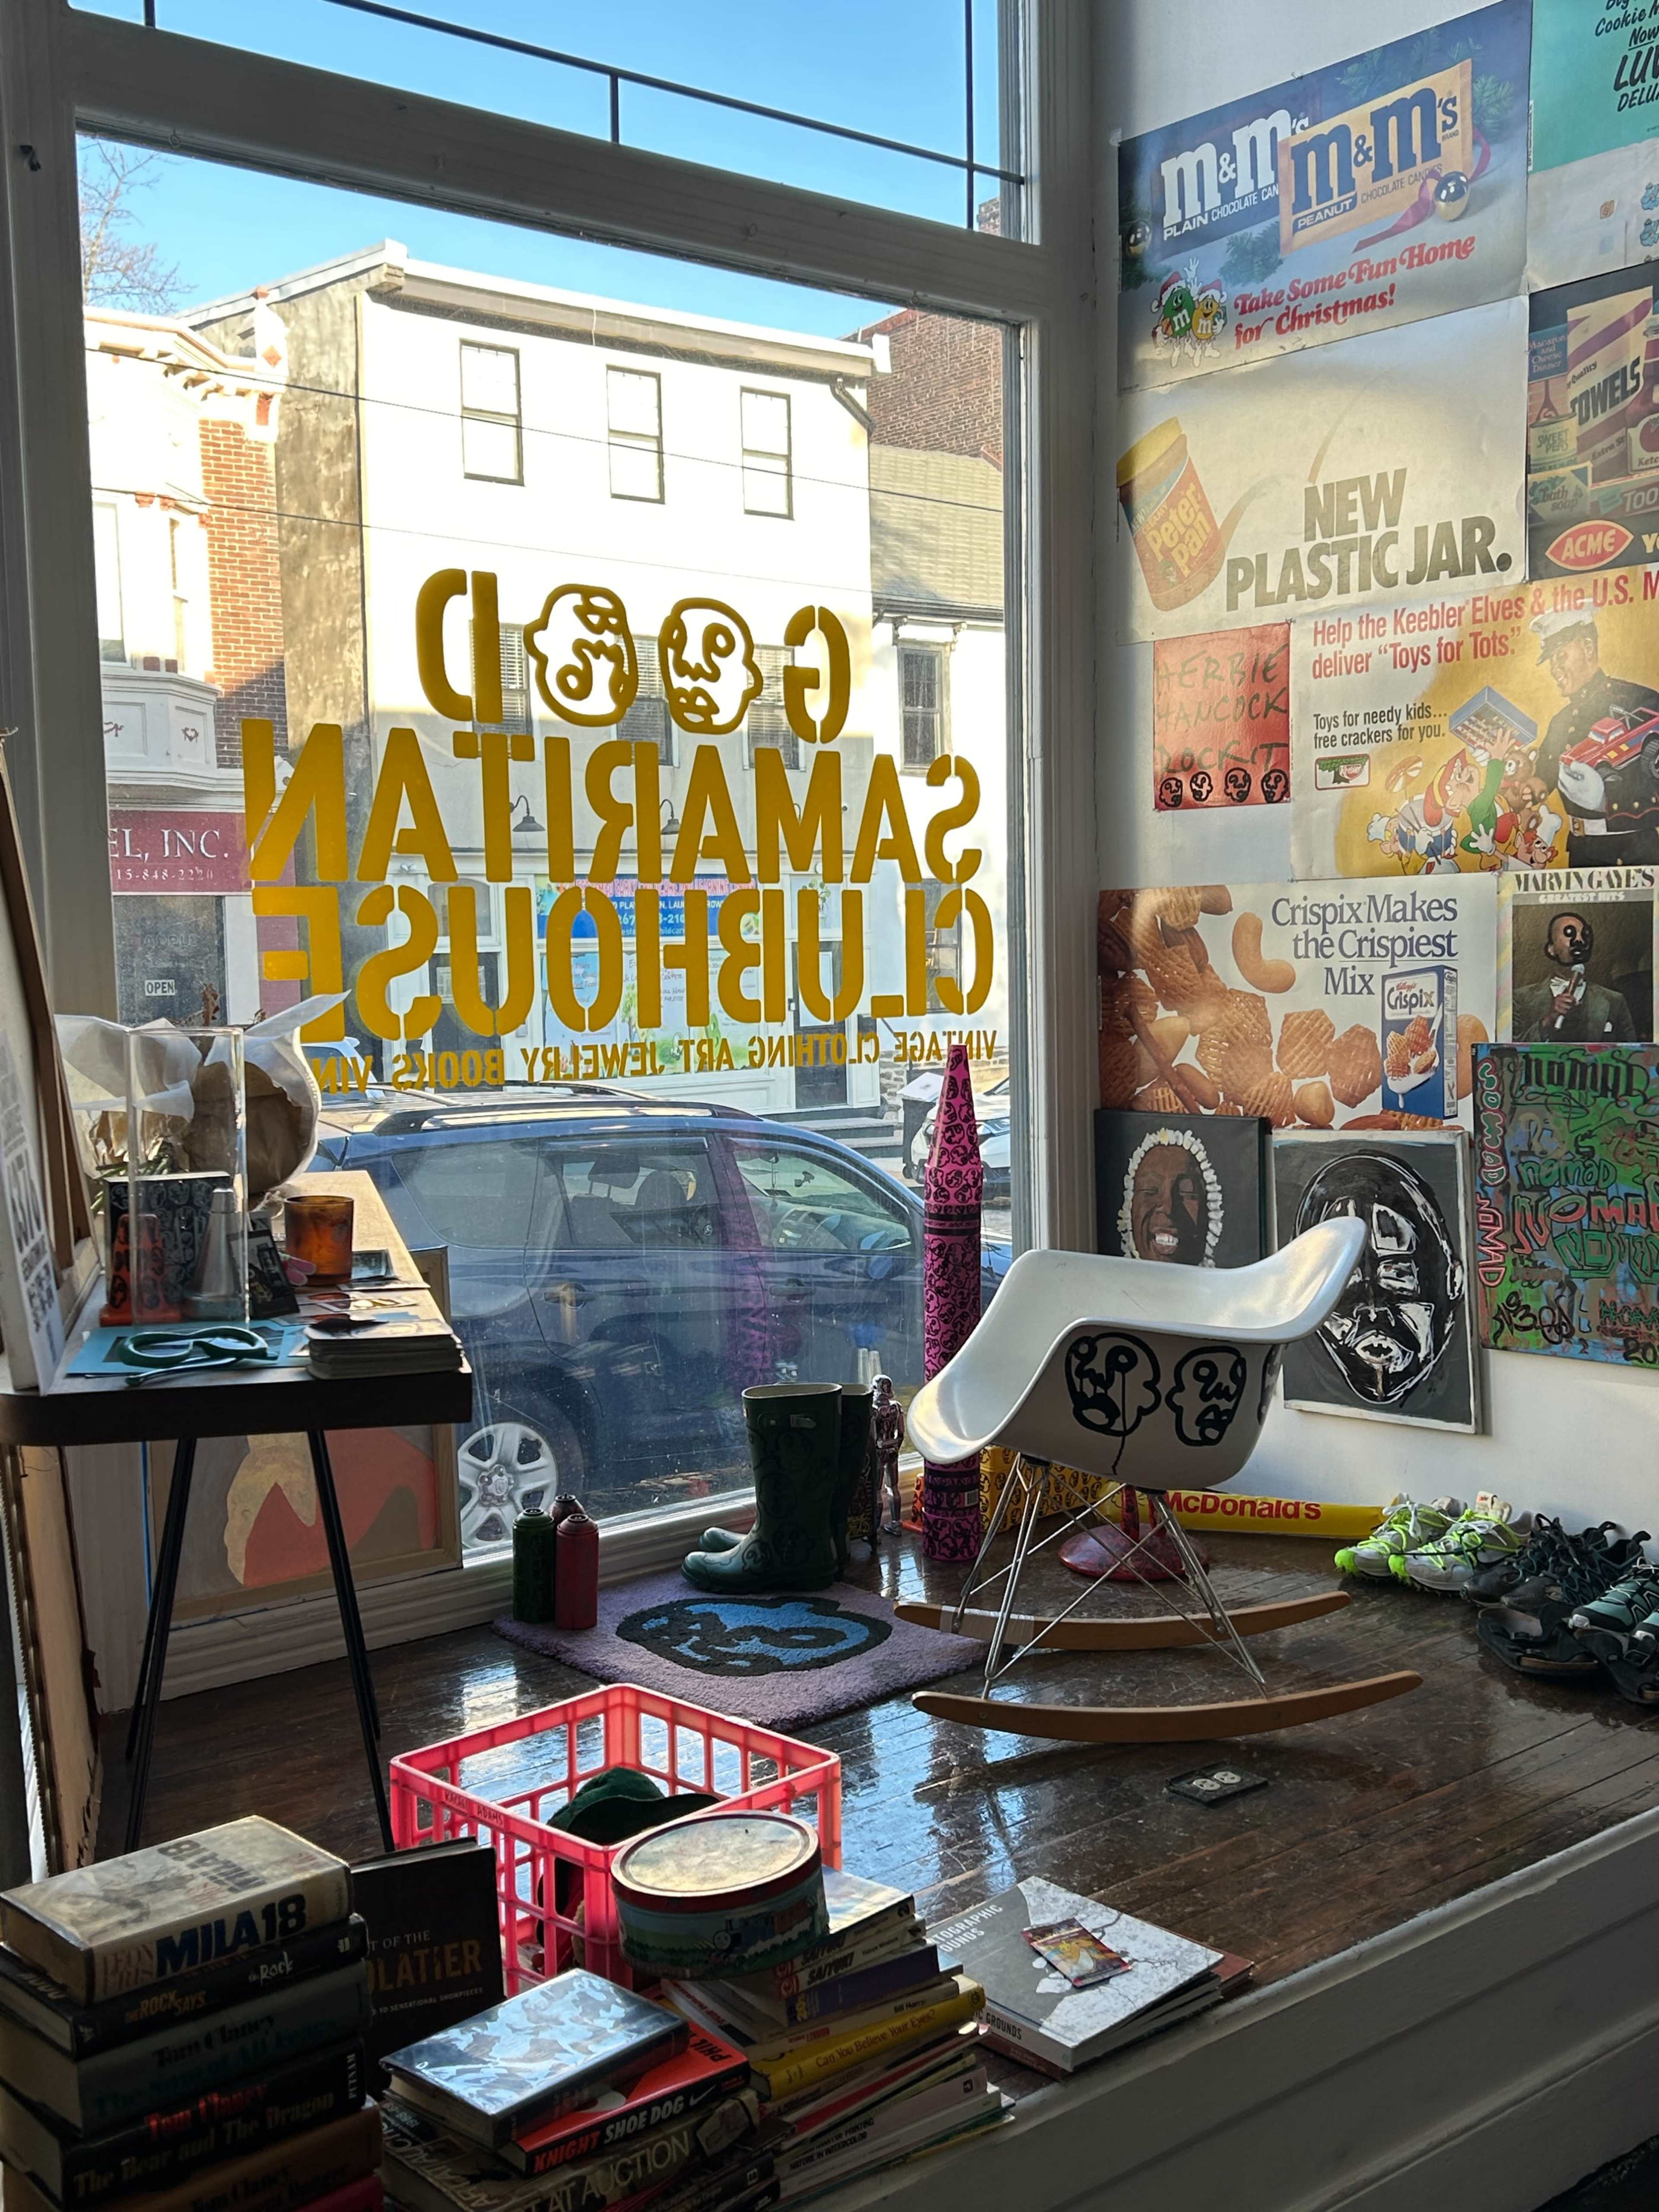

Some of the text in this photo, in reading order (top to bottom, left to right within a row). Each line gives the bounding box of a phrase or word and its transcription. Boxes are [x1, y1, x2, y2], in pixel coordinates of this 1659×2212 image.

[1595, 8, 1646, 37] Cookie
[1442, 130, 1459, 142] BRAND
[1211, 192, 1258, 222] CHOCOLATE
[1361, 178, 1405, 204] CHOCOLATE
[1163, 212, 1208, 241] PLAIN
[1297, 199, 1353, 229] PEANUT
[1233, 235, 1476, 317] Take Some Fun Home
[1234, 283, 1396, 350] for Christmas!
[1570, 356, 1640, 426] TOWELS
[1304, 467, 1408, 542] NEW
[1561, 529, 1616, 561] ACME
[1226, 515, 1512, 612] PLASTIC JAR.
[1313, 617, 1352, 648] Help
[1358, 613, 1387, 641] the
[1393, 601, 1466, 636] Keebler
[1471, 595, 1525, 625] Elves
[1530, 588, 1546, 617] &
[1552, 584, 1585, 613] the
[1593, 574, 1634, 608] U.S.
[1155, 643, 1289, 691] HERBIE
[1313, 649, 1372, 680] deliver
[1437, 636, 1464, 664] for
[1155, 686, 1288, 734] HANCOCK
[1313, 712, 1340, 732] Toys
[1343, 710, 1360, 727] for
[1363, 706, 1402, 725] needy
[1313, 723, 1446, 749] free crackers for you.
[161, 829, 229, 858] INC.
[1515, 869, 1585, 892] MARVIN
[1271, 890, 1458, 935] Crispix Makes
[1538, 891, 1626, 904] GREATEST HITS
[1292, 926, 1459, 968] the Crispiest
[146, 981, 175, 994] OPEN
[1324, 965, 1375, 995] Mix
[1387, 987, 1435, 1015] Crispix
[1166, 1492, 1322, 1520] McDonald's
[156, 1909, 261, 1979] MILA
[262, 1894, 306, 1940] 18
[382, 1929, 431, 1950] OF THE
[259, 1951, 294, 1986] Rock
[140, 1990, 176, 2018] ROCK
[815, 2009, 936, 2069] Can You Believe Your Eyes?
[985, 2011, 1023, 2040] GROUNDS
[143, 2082, 267, 2140] Tom Clancy
[74, 2091, 335, 2197] The Bear and The Dragon
[532, 2095, 685, 2175] KNIGHT SHOE DOG
[582, 2130, 691, 2206] AUCTION
